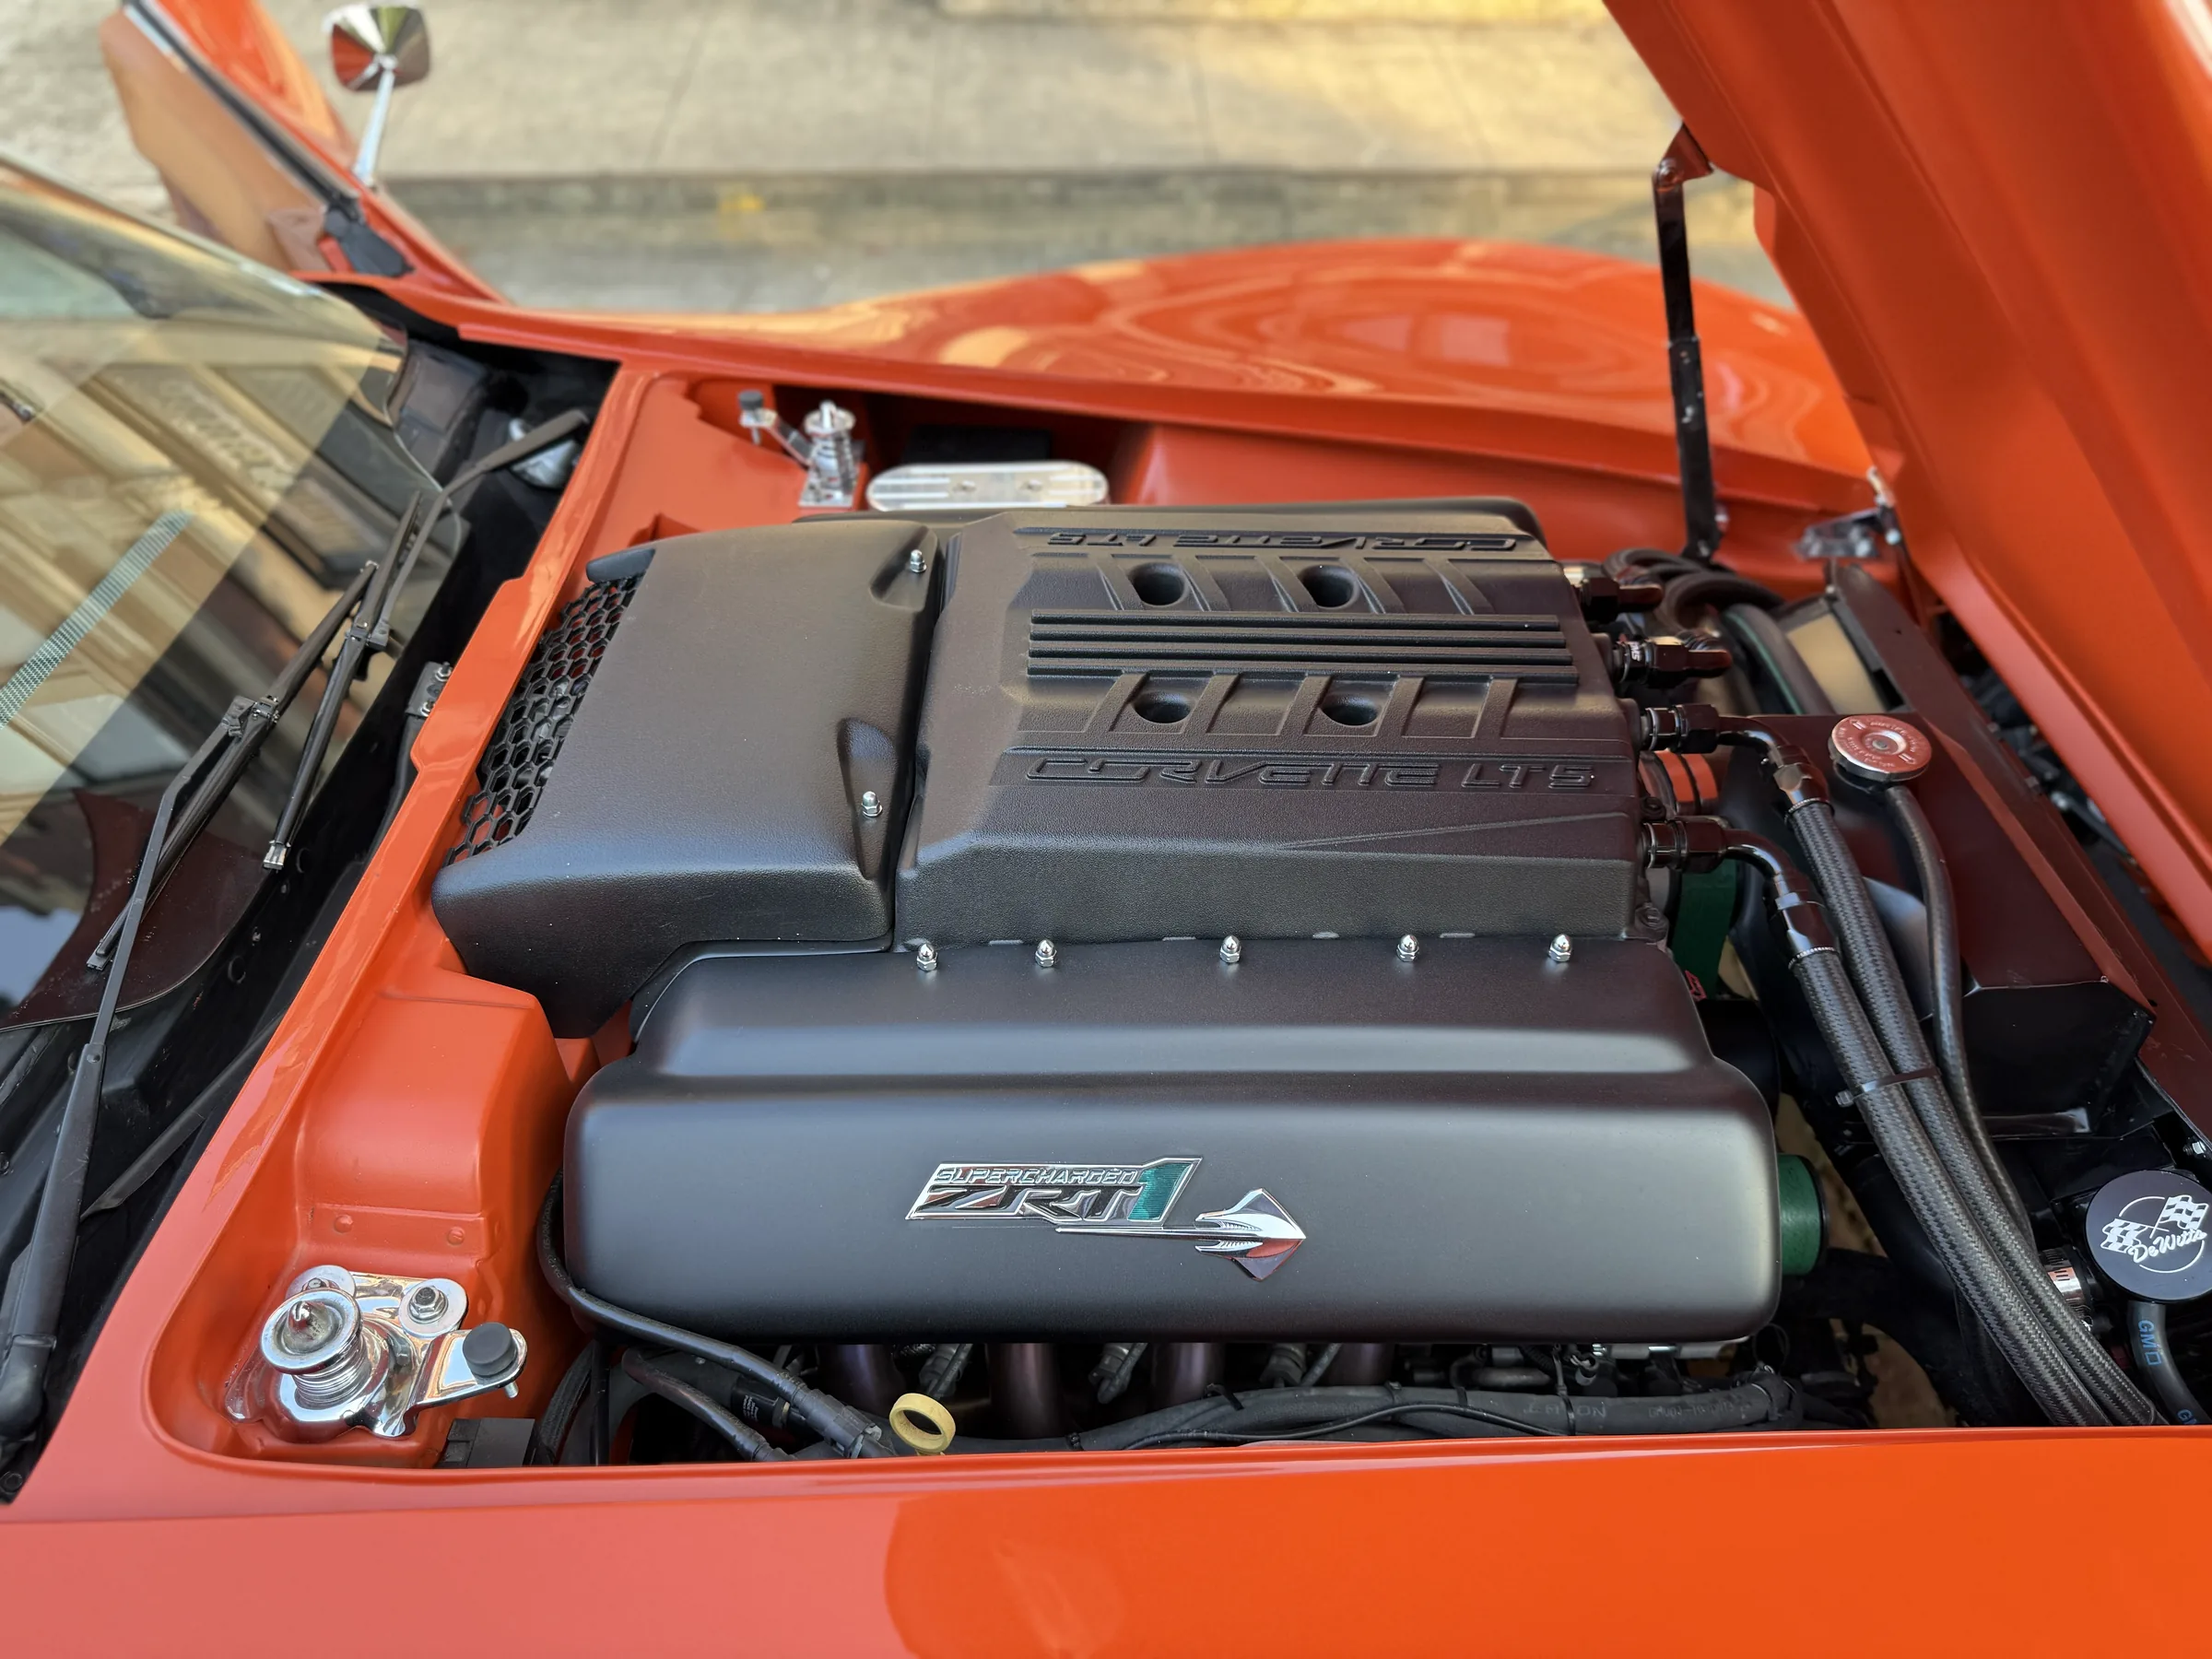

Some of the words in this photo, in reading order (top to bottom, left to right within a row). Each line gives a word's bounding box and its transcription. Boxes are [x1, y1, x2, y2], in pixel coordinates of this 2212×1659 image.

[1173, 534, 1519, 551] CORVETTE
[1026, 757, 1441, 786] CORVETTE
[934, 1165, 1142, 1186] SUPERCHARGED
